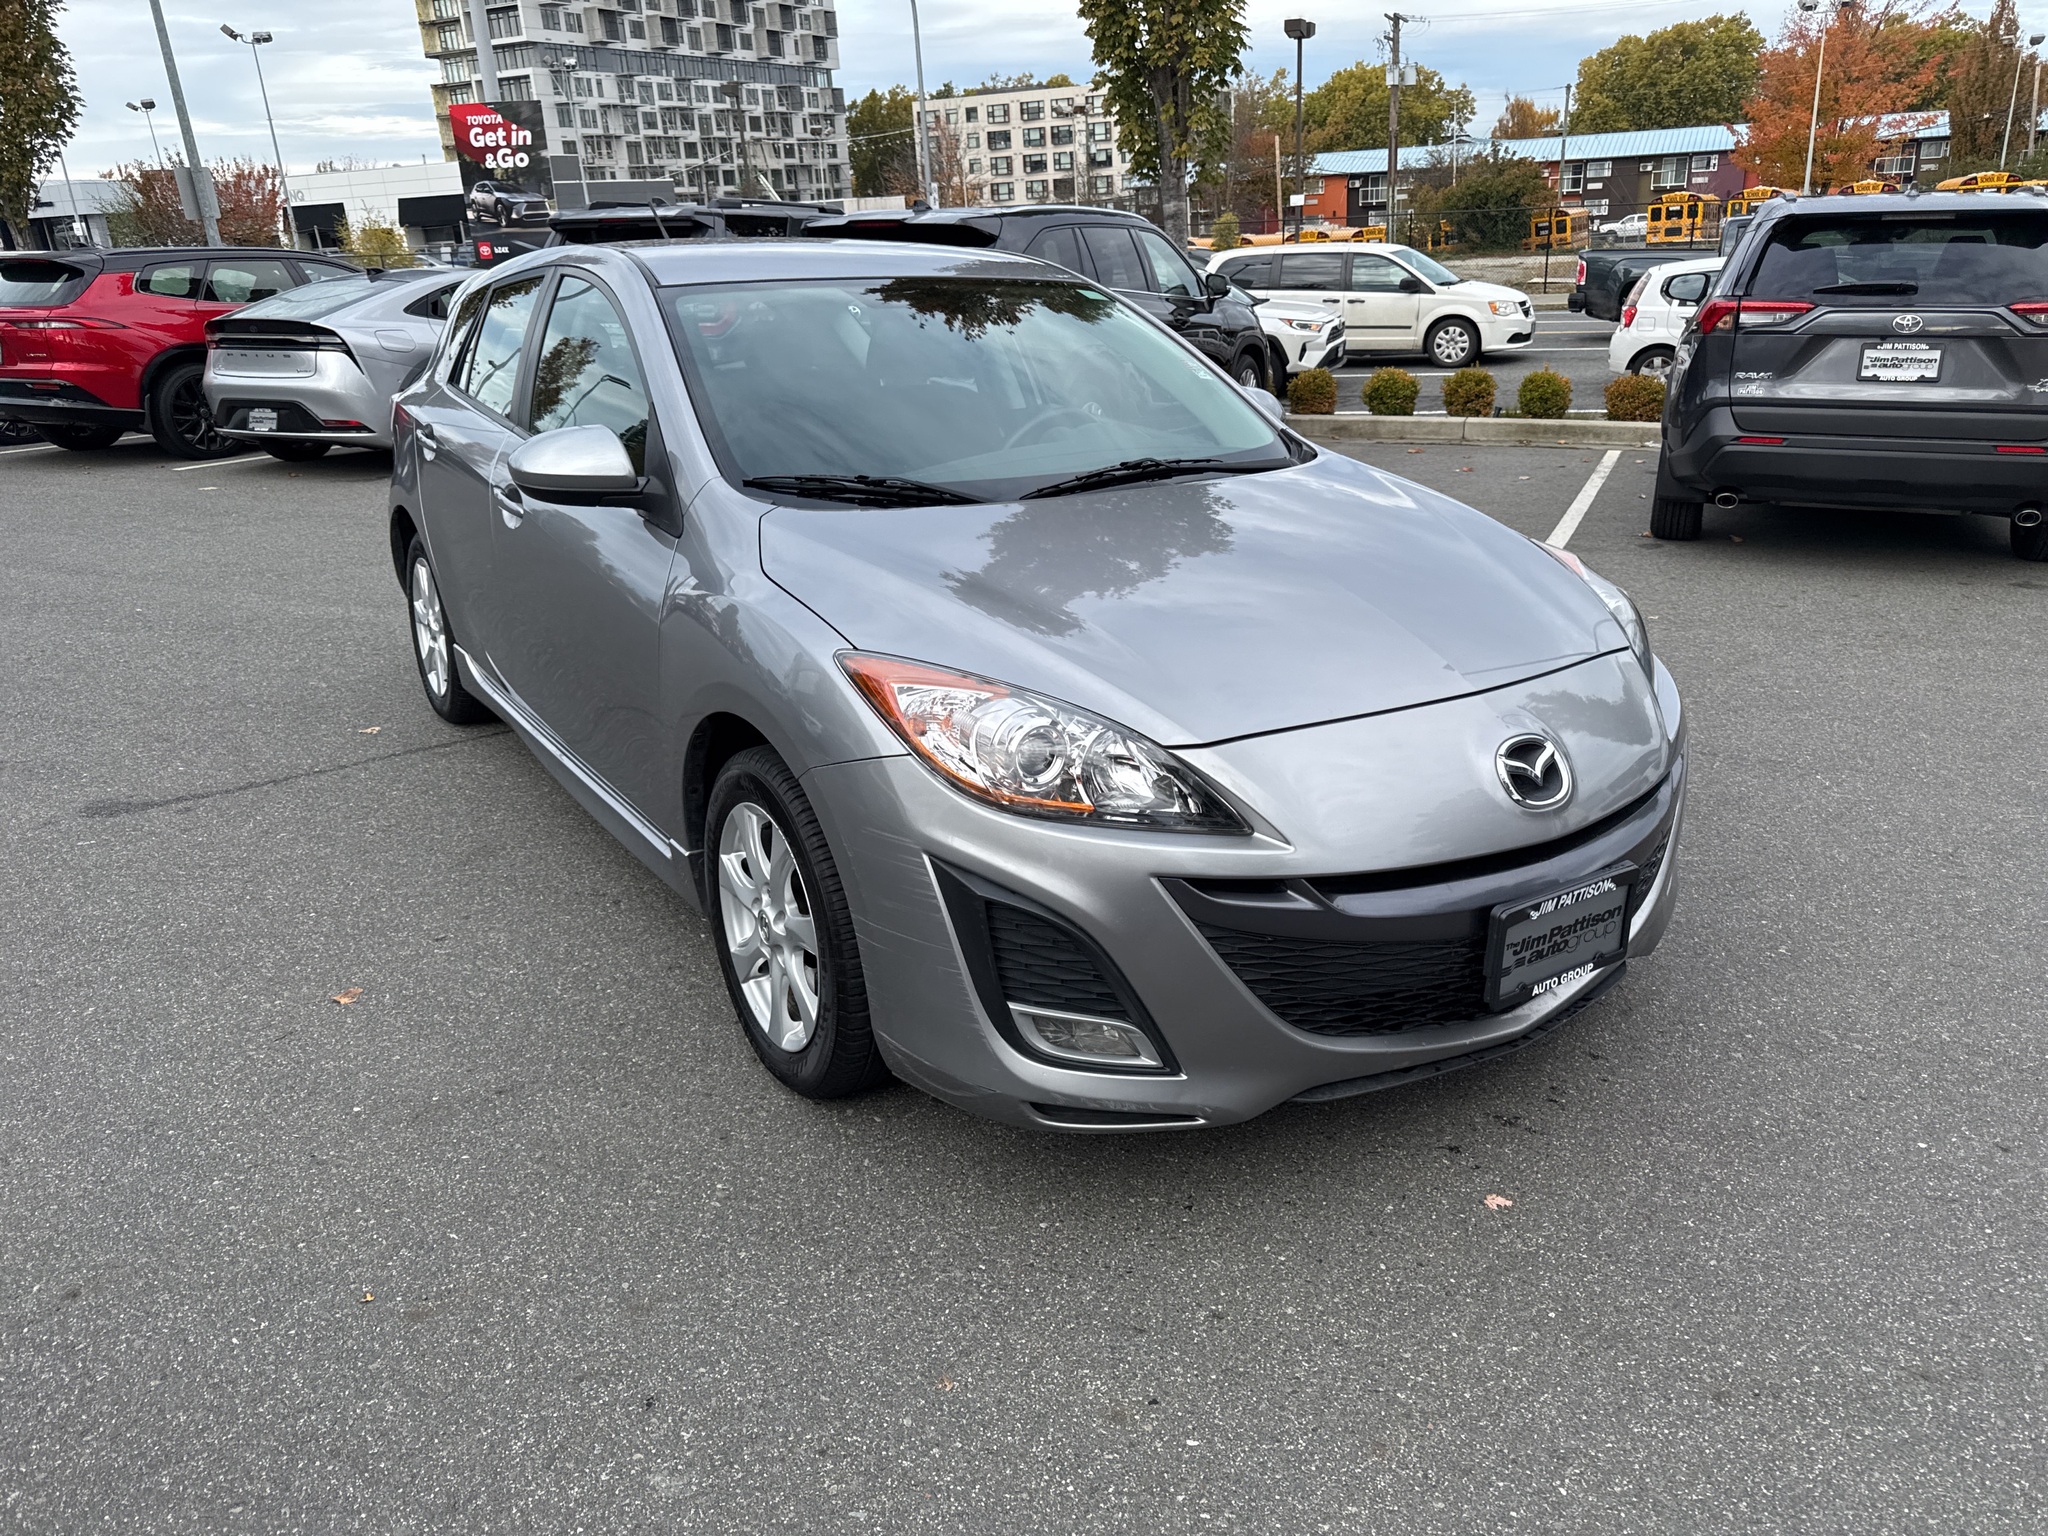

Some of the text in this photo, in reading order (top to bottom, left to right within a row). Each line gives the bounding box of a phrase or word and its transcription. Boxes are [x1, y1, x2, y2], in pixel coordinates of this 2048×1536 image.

[466, 114, 503, 126] TOYOTA
[469, 124, 532, 148] Get in
[485, 148, 530, 169] &Go
[1734, 371, 1773, 379] RAV4
[1536, 878, 1612, 917] JIM PATTISON
[1531, 962, 1594, 997] AUTO GROUP
